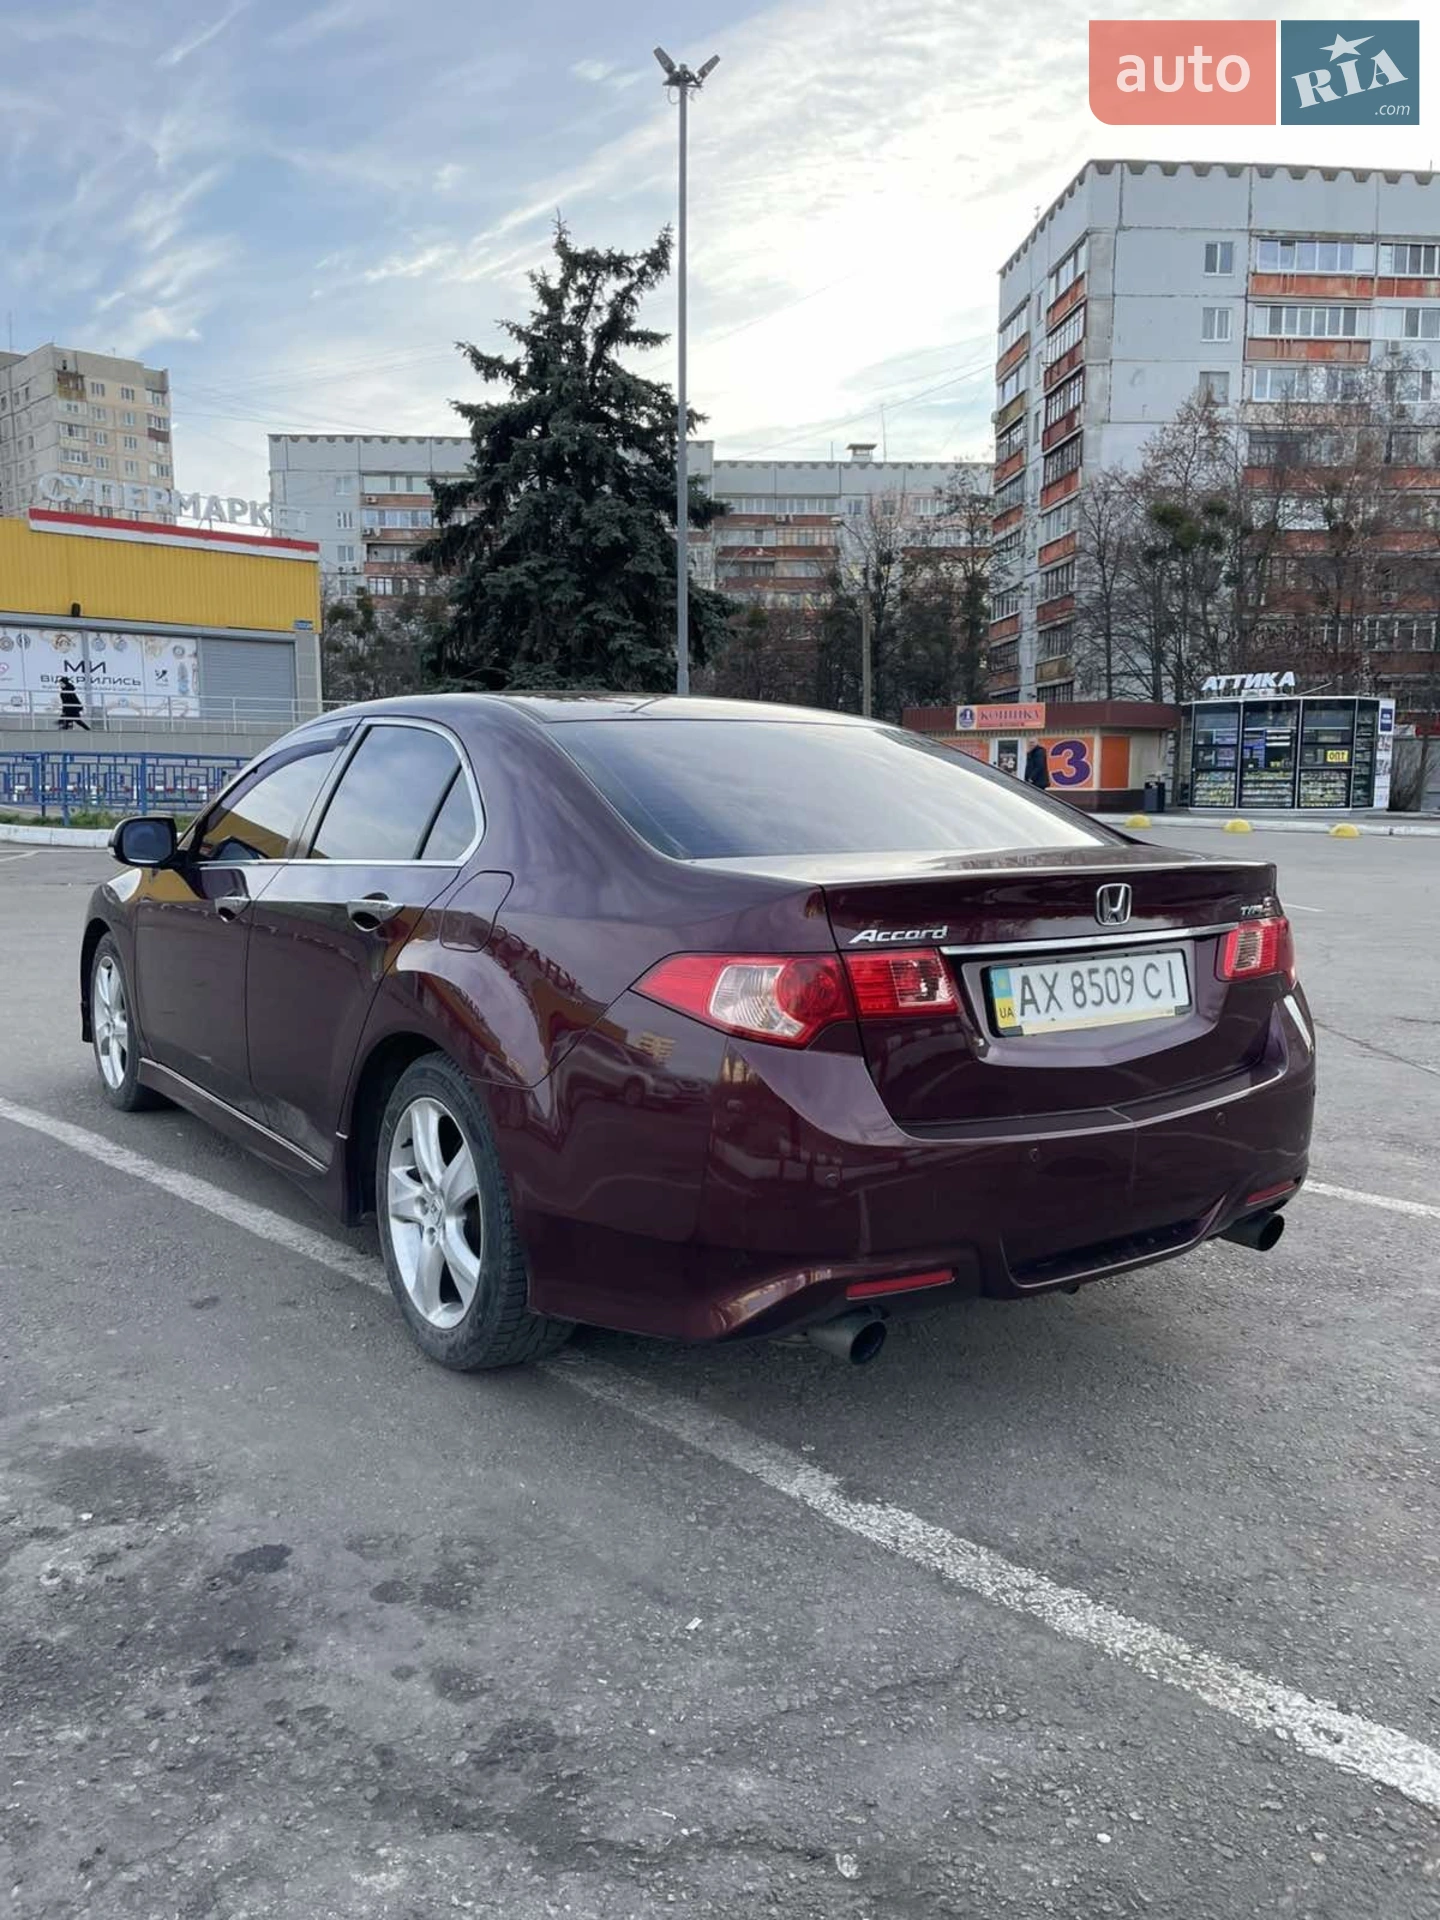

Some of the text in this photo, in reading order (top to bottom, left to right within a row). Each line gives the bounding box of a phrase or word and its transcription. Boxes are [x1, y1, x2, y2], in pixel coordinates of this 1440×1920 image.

[39, 472, 311, 532] СУПЕРМАРКЕТ
[64, 659, 106, 674] МИ
[1201, 671, 1296, 691] АТТИКА
[1050, 739, 1092, 787] 3
[848, 925, 948, 944] Accord
[1020, 971, 1063, 1017] AX
[1071, 965, 1134, 1009] 8509
[1000, 1007, 1014, 1019] UA
